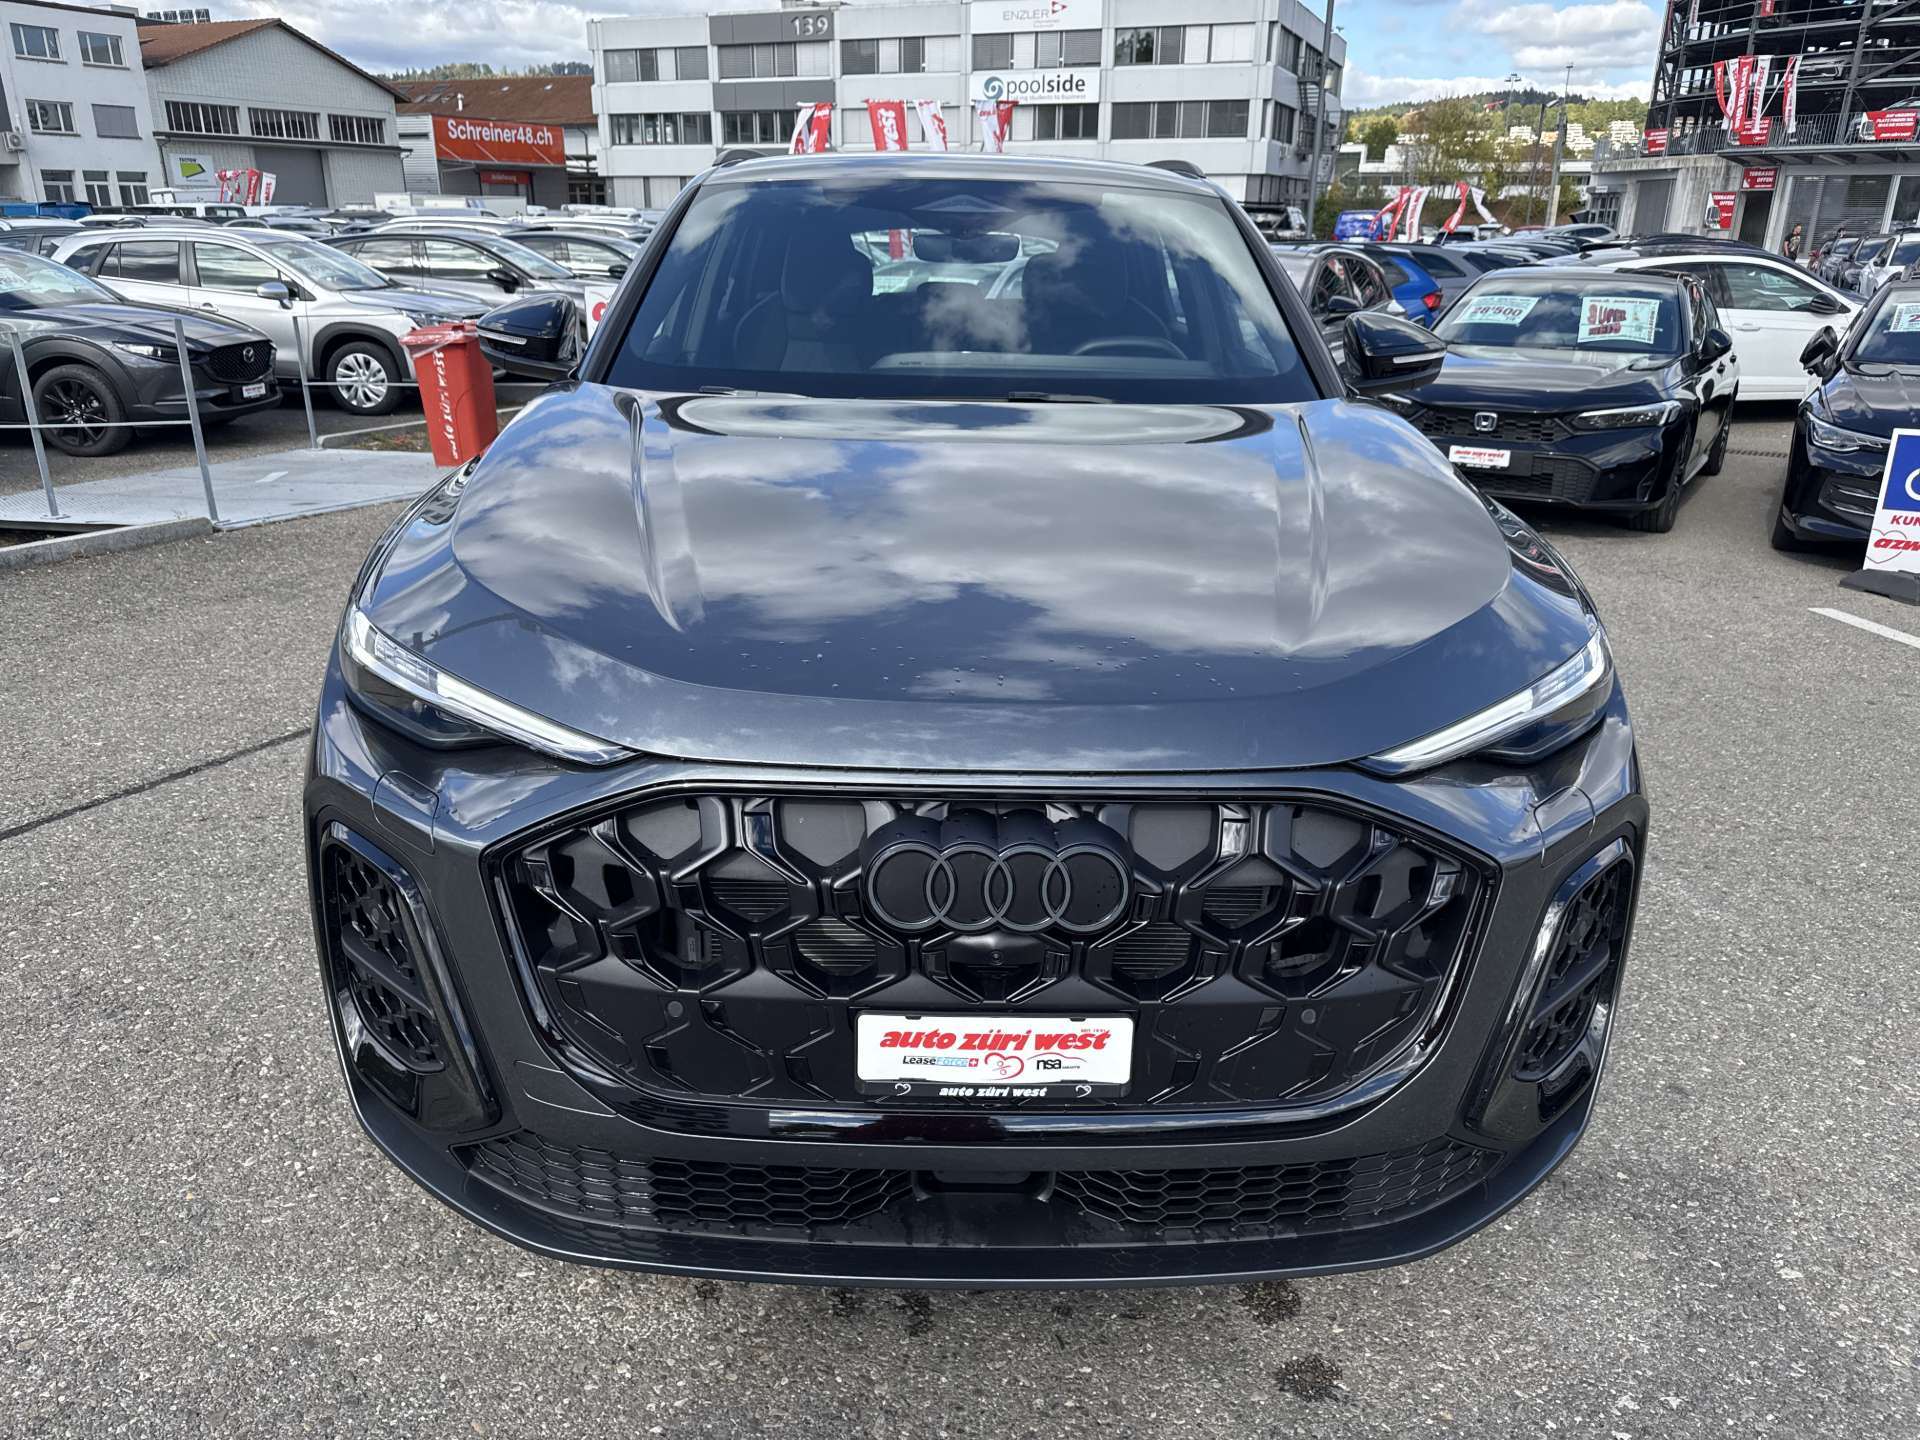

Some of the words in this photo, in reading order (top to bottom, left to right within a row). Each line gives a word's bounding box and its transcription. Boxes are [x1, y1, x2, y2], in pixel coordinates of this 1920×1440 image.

[1002, 9, 1049, 21] ENZLER
[791, 16, 829, 36] 139
[1007, 73, 1086, 101] poolside
[447, 118, 553, 146] Schreiner48.ch
[880, 1029, 957, 1050] auto
[957, 1028, 1032, 1051] züri
[1034, 1029, 1111, 1051] west
[1037, 1059, 1062, 1070] nsa
[939, 1087, 974, 1097] auto
[976, 1086, 1010, 1097] züri
[1012, 1087, 1048, 1097] west
